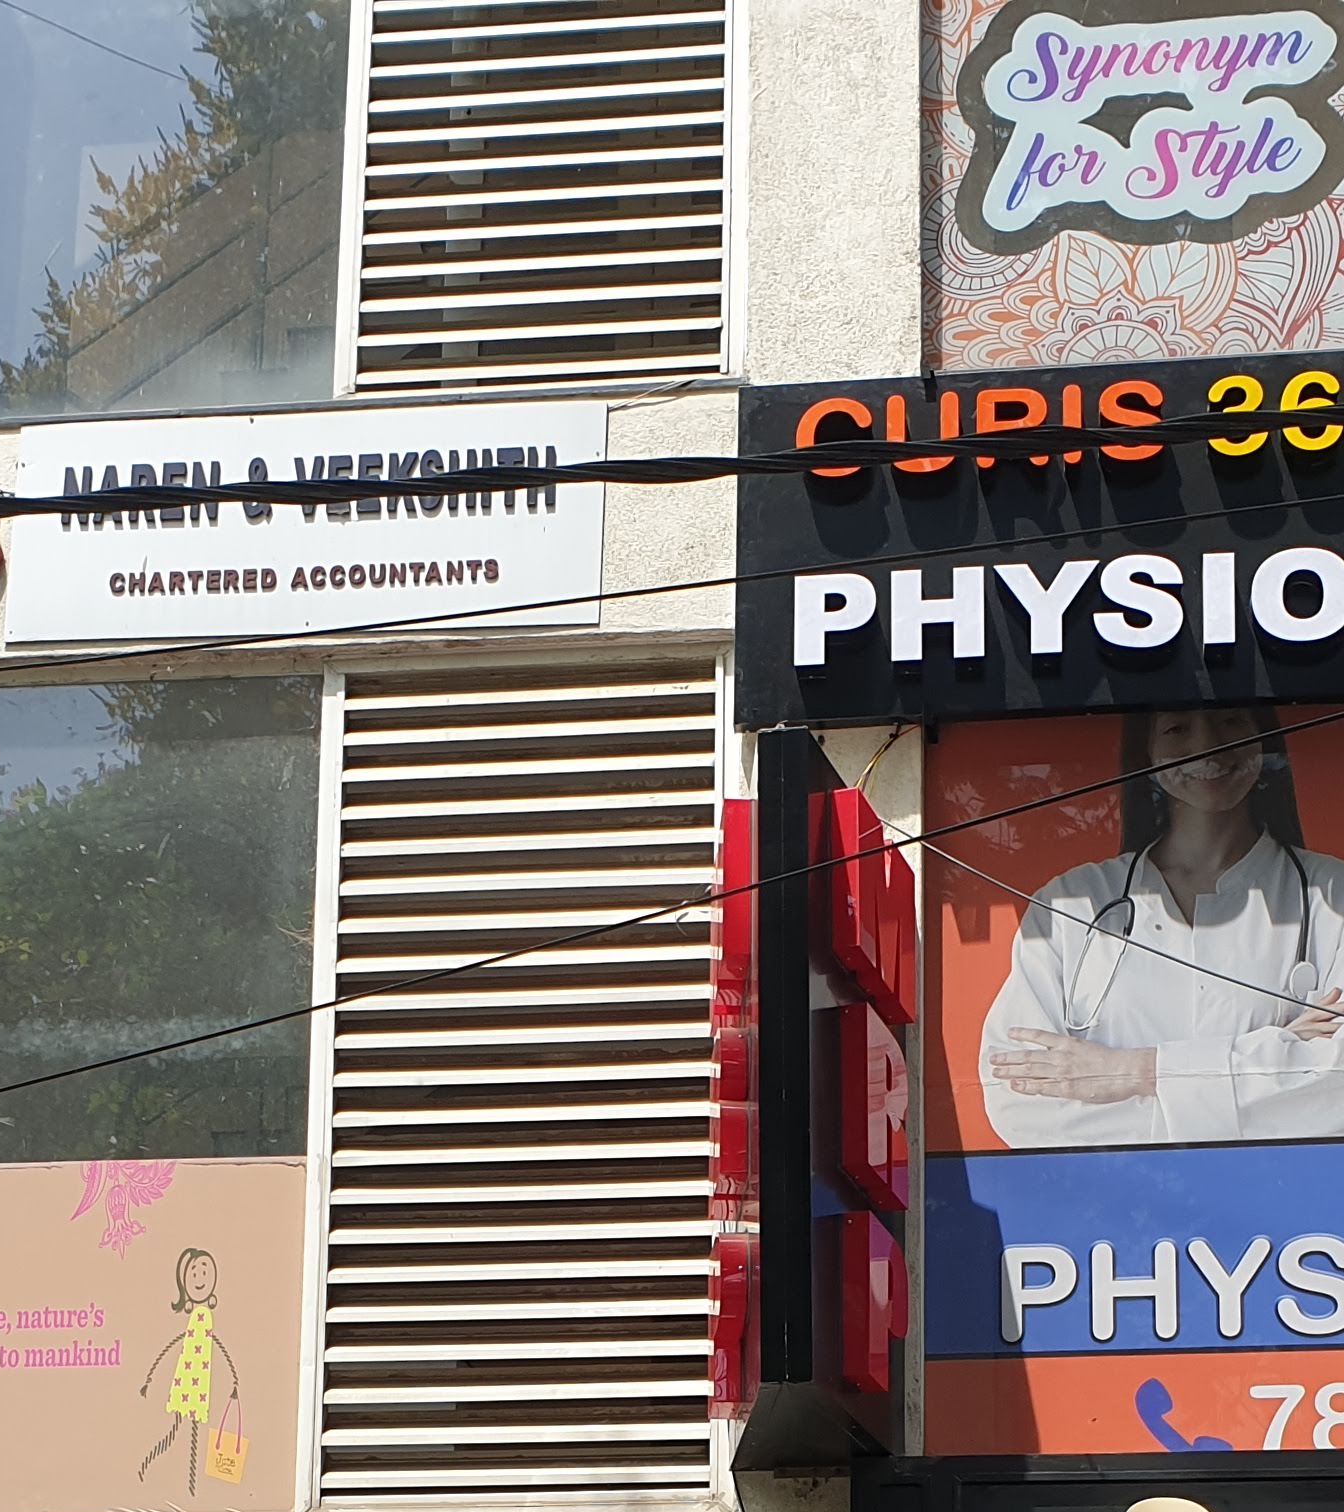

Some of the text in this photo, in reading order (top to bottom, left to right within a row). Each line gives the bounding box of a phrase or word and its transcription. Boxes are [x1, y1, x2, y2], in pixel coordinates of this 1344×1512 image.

[1008, 11, 1311, 102] Synonym
[1006, 114, 1301, 211] for Style
[796, 380, 1165, 478] CURIS
[61, 445, 557, 531] NAREN & VEEKSHITH
[109, 558, 500, 596] CHARTERED ACCOUNTANTS
[0, 1346, 20, 1369] to
[23, 1340, 121, 1369] mankind
[16, 1302, 104, 1330] nature's
